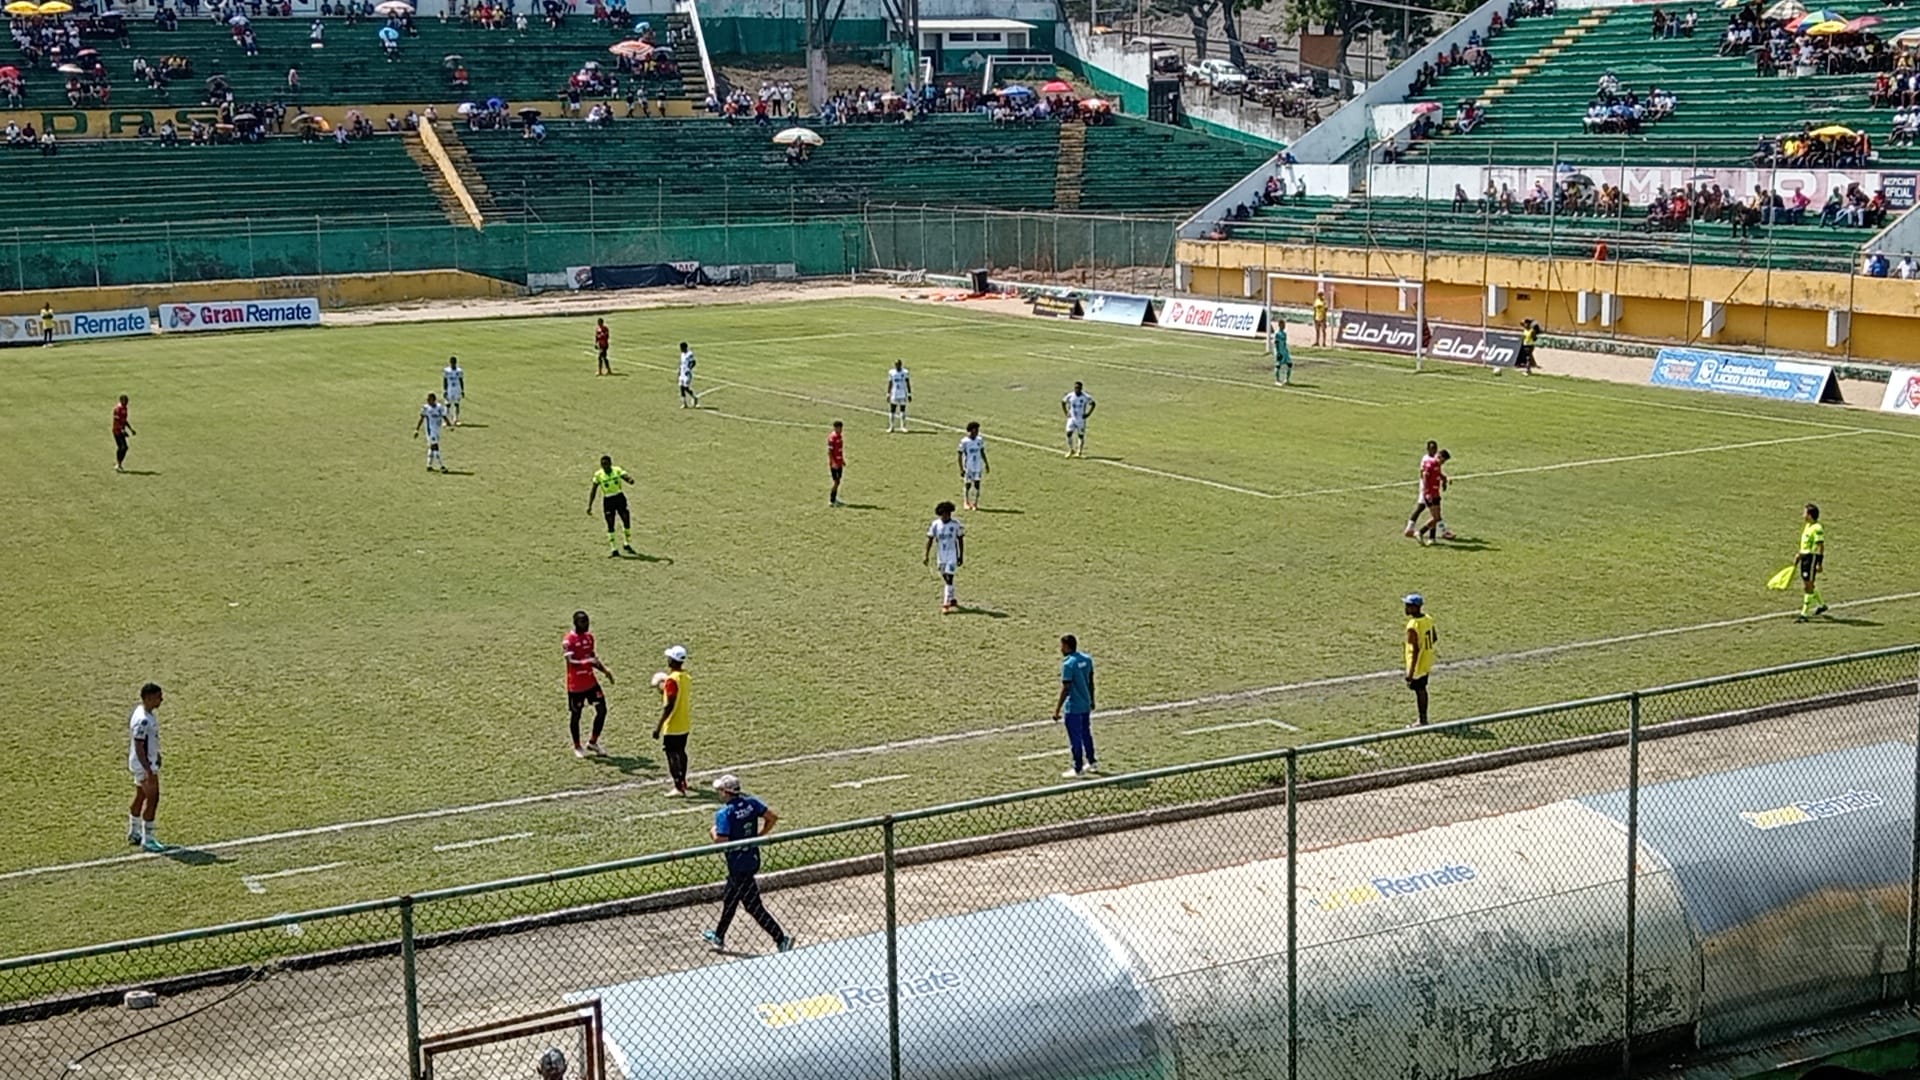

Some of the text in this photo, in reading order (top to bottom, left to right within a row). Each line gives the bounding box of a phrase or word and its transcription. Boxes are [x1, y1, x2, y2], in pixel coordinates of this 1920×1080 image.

[74, 313, 145, 335] Remate
[200, 303, 312, 324] Gran Remate
[1185, 305, 1254, 331] Gran Remate
[1342, 321, 1416, 346] elohim
[1433, 336, 1514, 362] elohim
[1714, 373, 1740, 384] LICEO
[1373, 864, 1476, 898] Remate
[839, 968, 962, 1009] Remate
